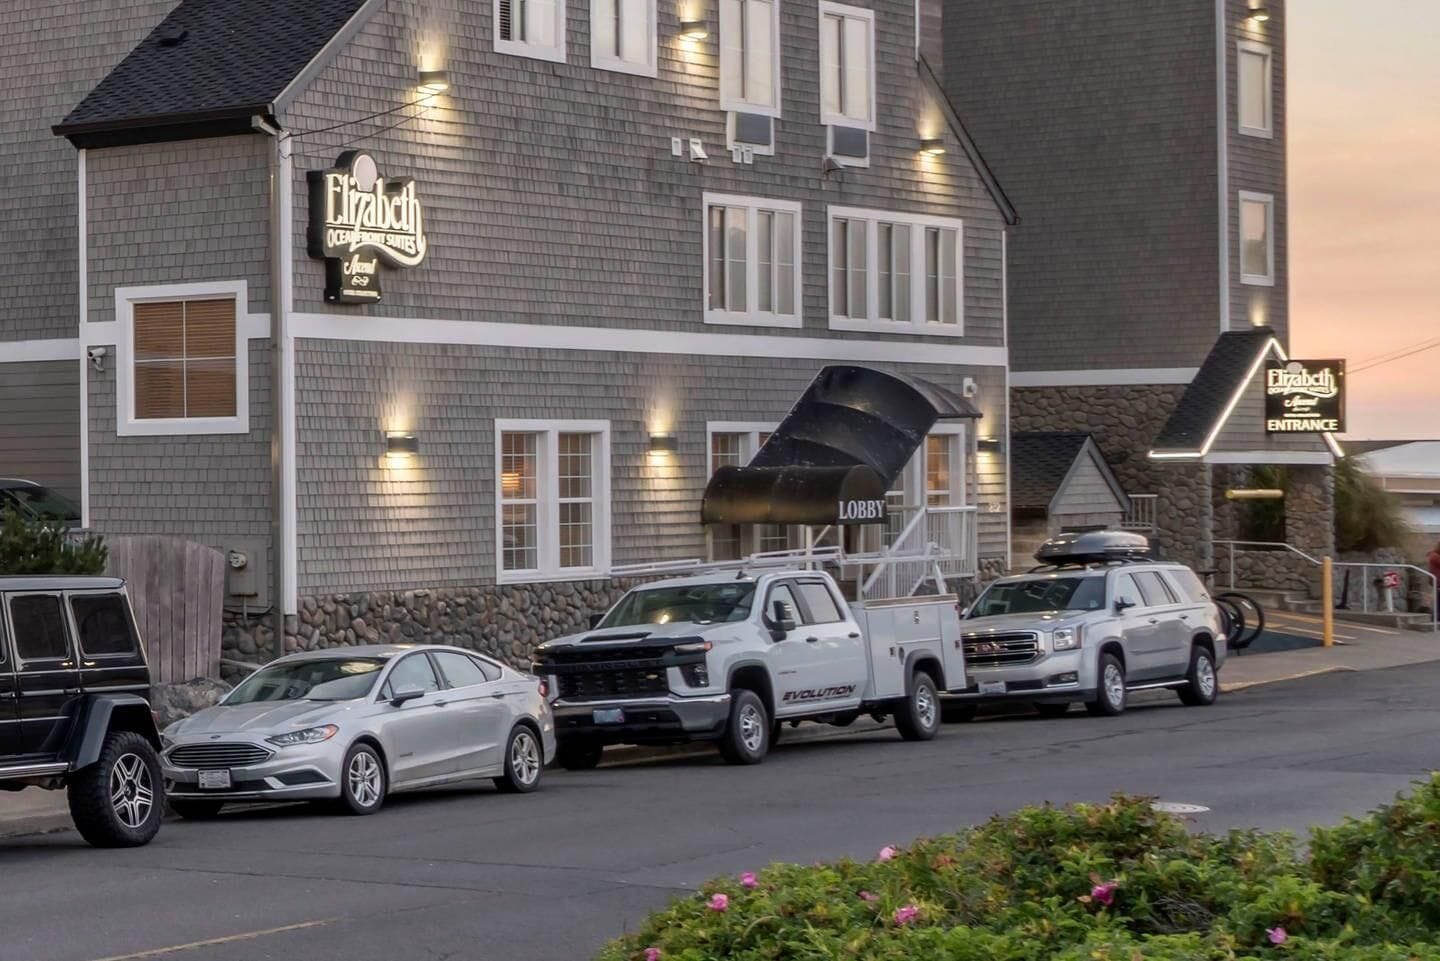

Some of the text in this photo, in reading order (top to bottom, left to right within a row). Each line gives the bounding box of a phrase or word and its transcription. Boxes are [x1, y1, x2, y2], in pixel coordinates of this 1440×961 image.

[325, 174, 426, 248] Elizabeth
[1267, 368, 1338, 392] Elizabeth
[1267, 419, 1338, 431] ENTRANCE
[838, 500, 885, 520] LOBBY
[782, 684, 857, 701] EVOLUTION
